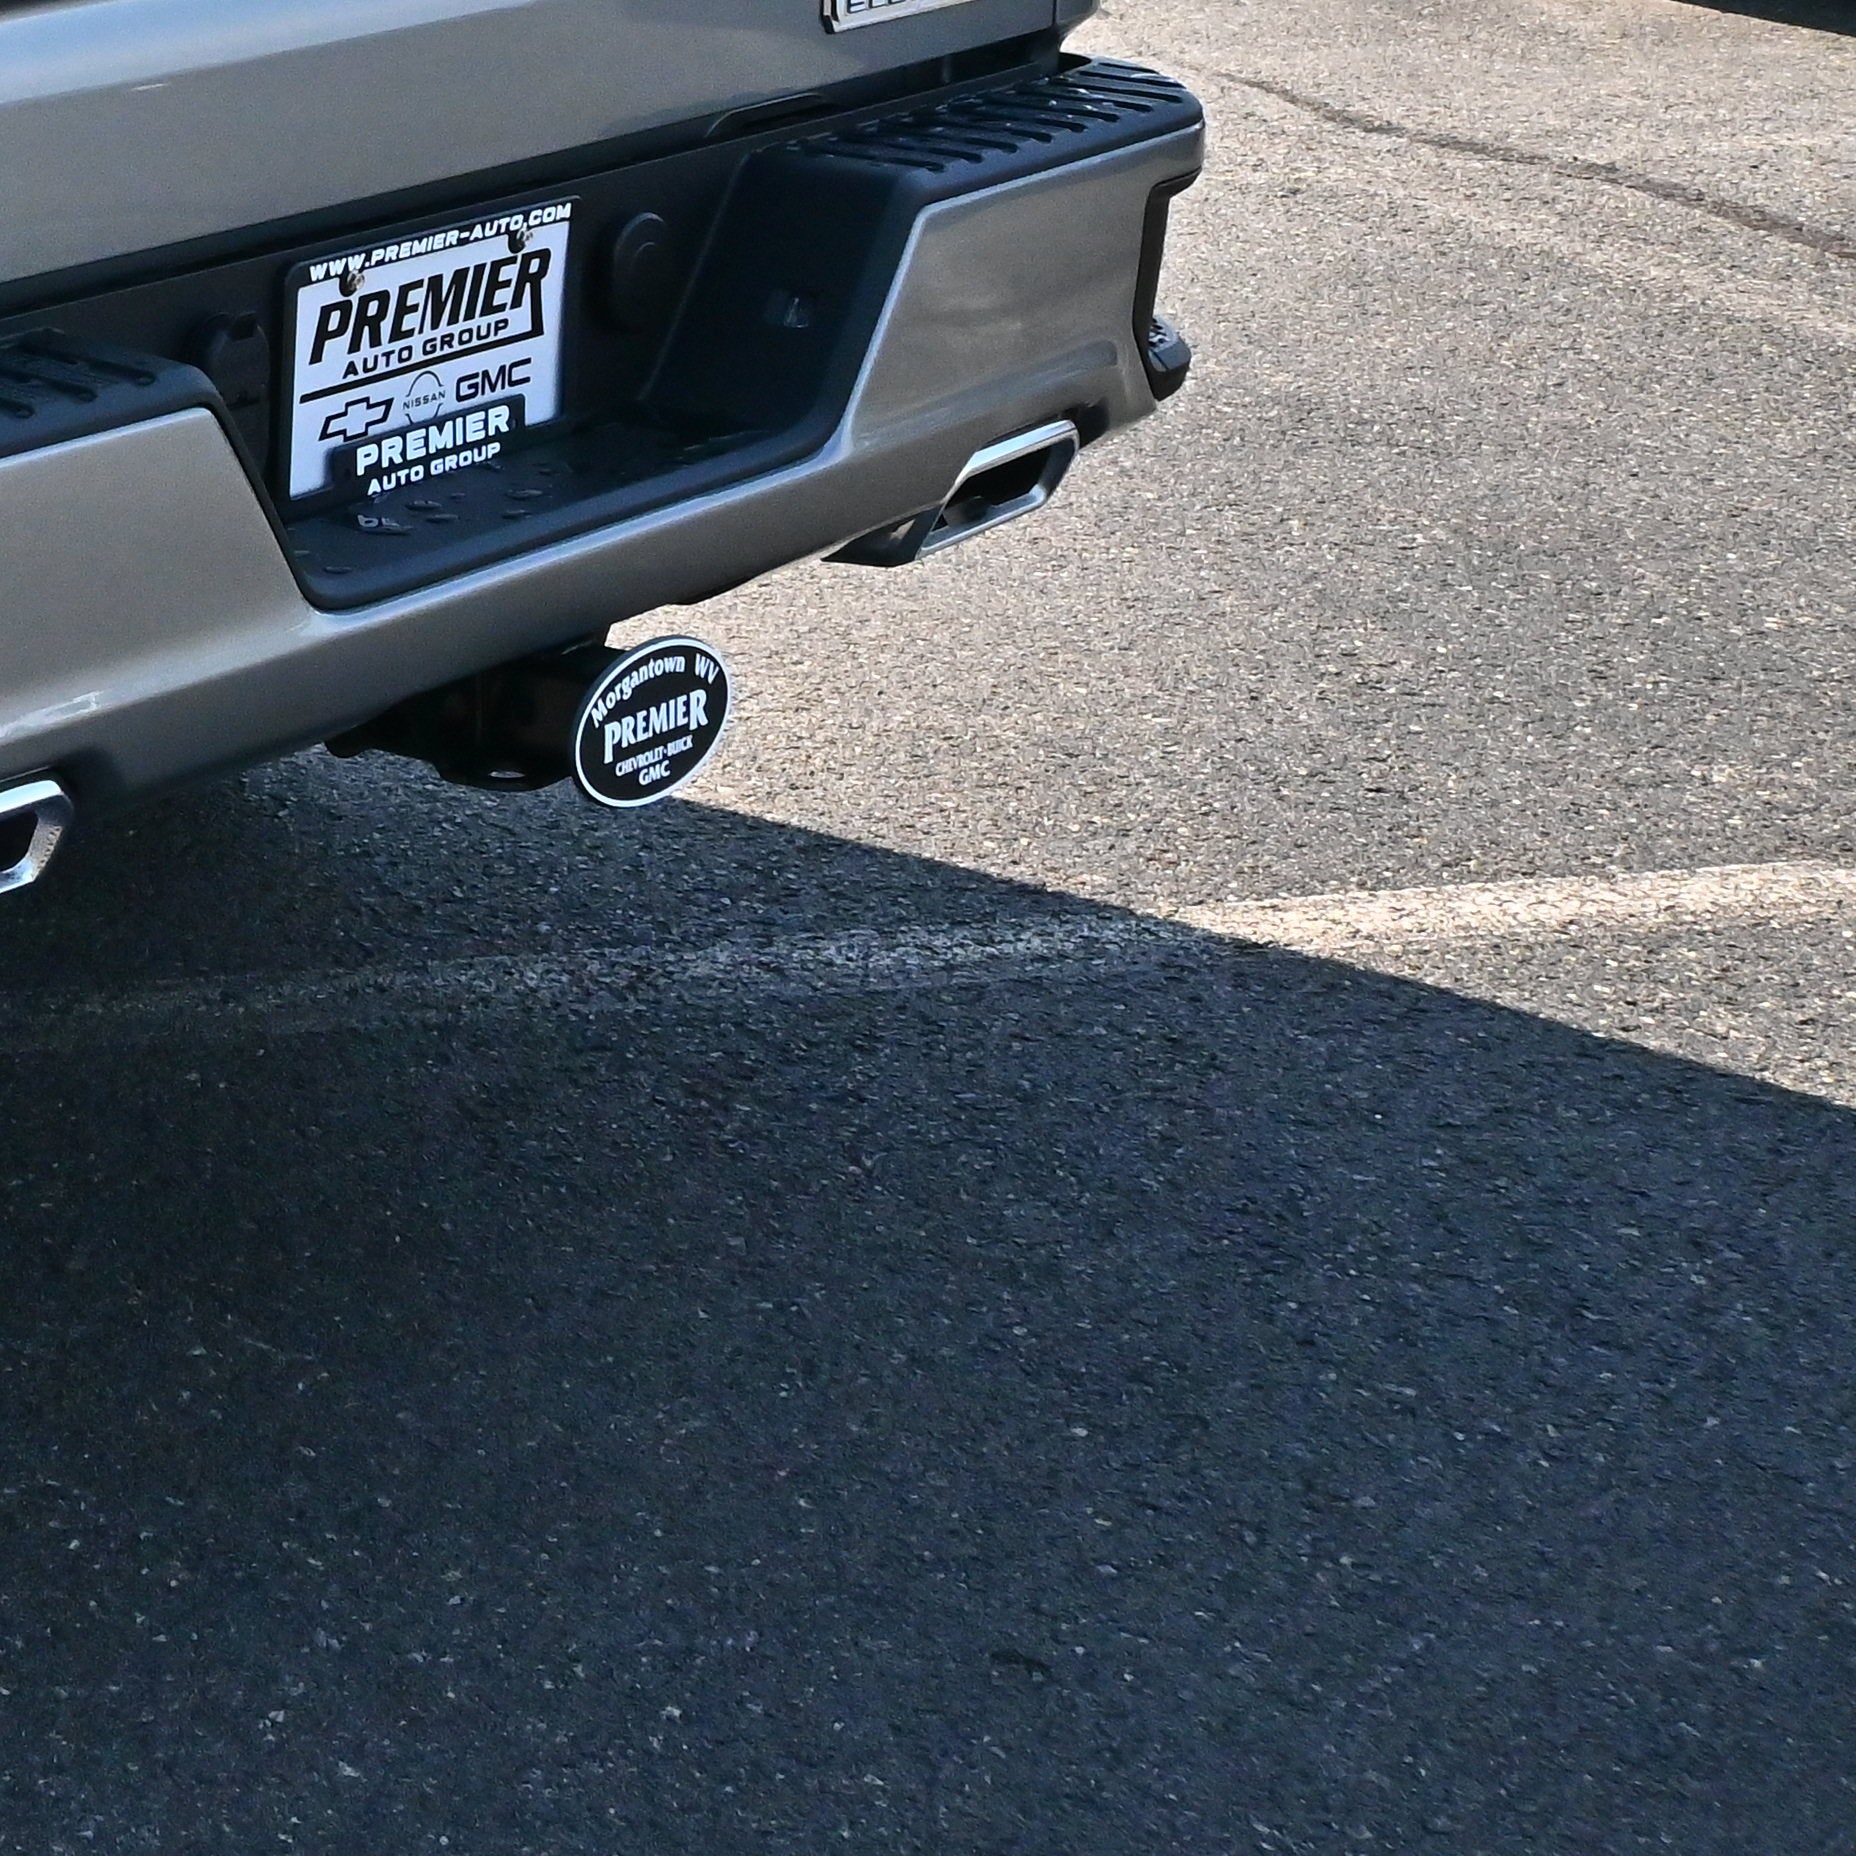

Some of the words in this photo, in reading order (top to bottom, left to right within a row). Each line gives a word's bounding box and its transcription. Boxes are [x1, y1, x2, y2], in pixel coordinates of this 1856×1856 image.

[309, 202, 572, 282] WWW.PREMIER-AUTO.COM
[308, 247, 551, 365] PREMIER
[343, 344, 413, 380] AUTO
[421, 318, 509, 356] GROUP
[454, 357, 532, 403] GMC
[402, 389, 446, 411] NISSAN
[356, 404, 510, 477] PREMIER
[367, 465, 424, 496] AUTO
[430, 442, 501, 476] GROUP
[590, 655, 686, 729] Morgantown
[695, 652, 720, 685] WV
[603, 688, 709, 764] PREMIER
[638, 760, 671, 786] GMC
